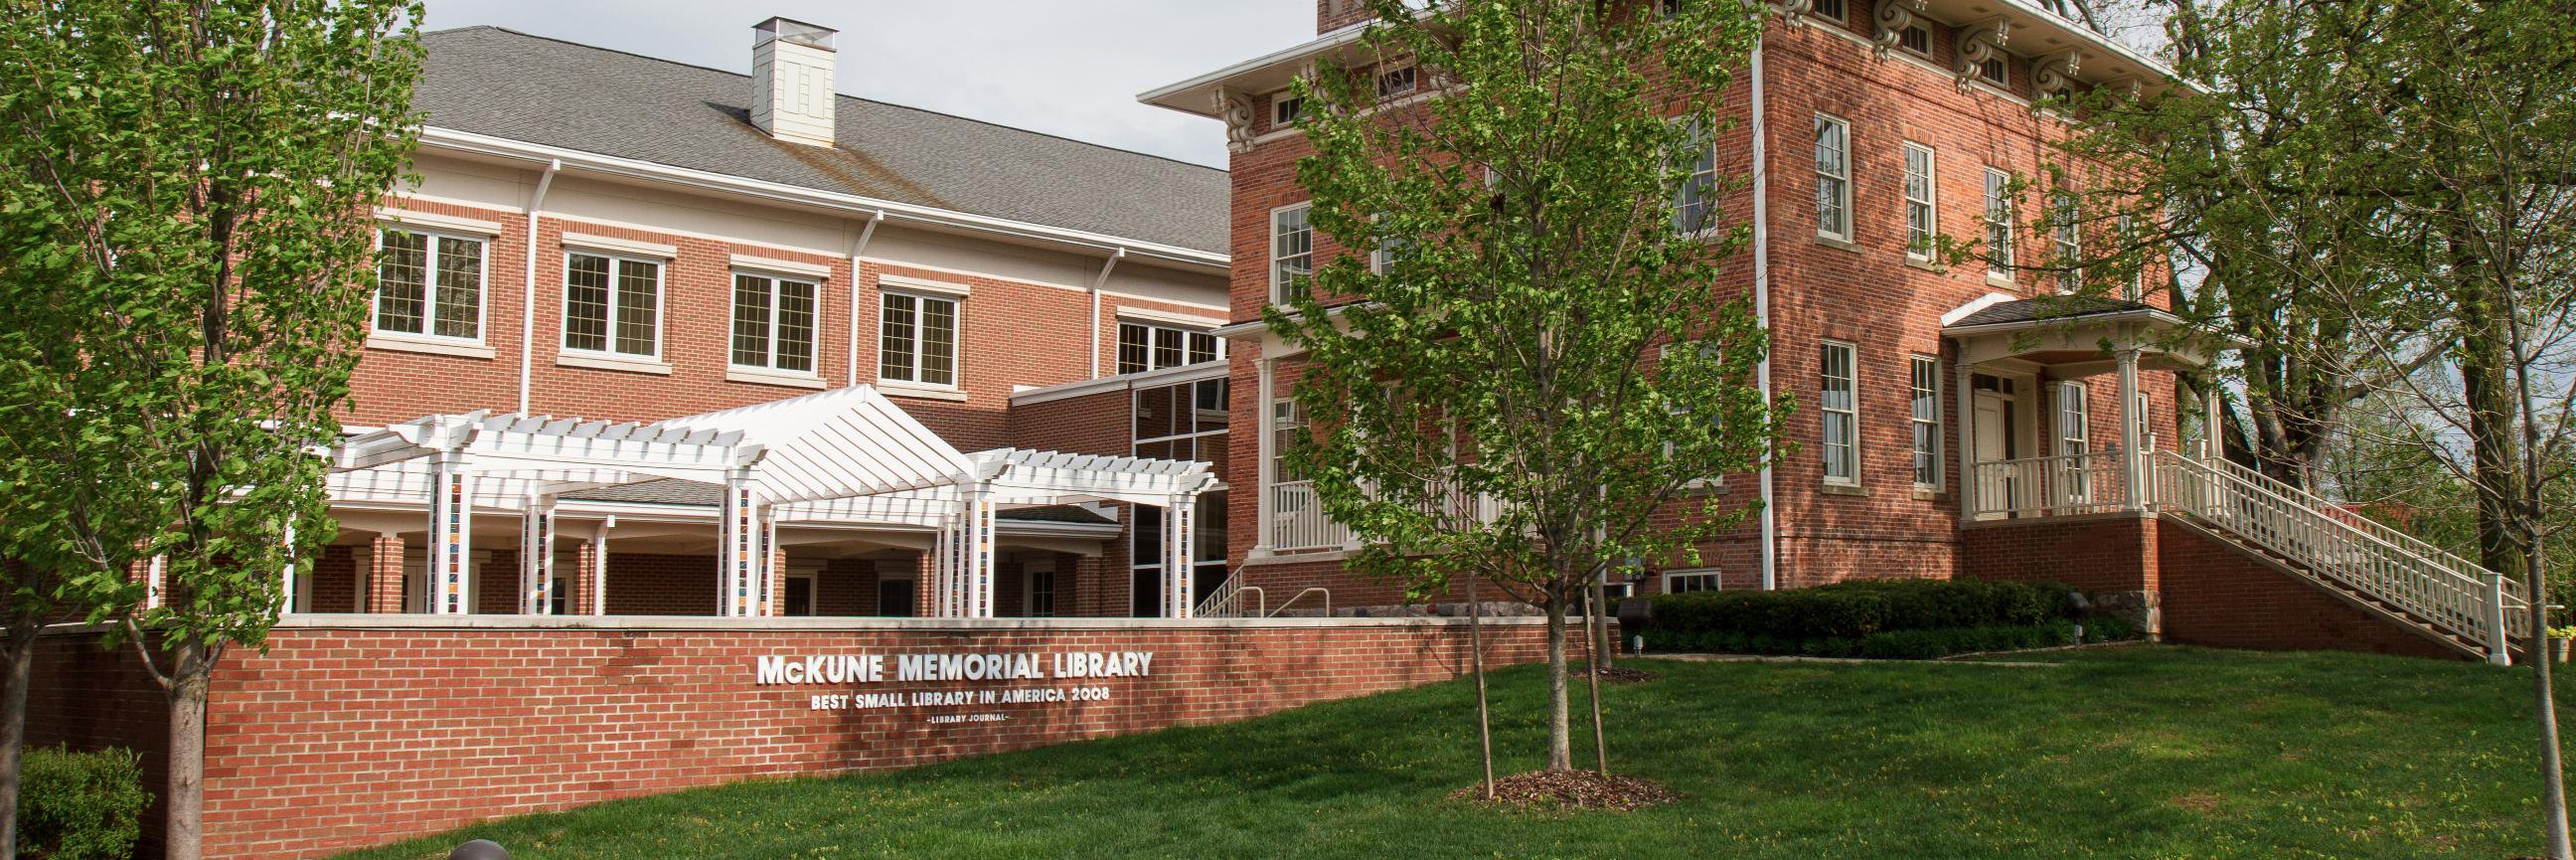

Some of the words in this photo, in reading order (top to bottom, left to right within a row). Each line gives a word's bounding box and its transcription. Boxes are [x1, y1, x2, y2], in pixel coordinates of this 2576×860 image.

[756, 655, 884, 684] McKUNE
[897, 653, 1045, 682] MEMORIAL
[1053, 652, 1154, 679] LIBRARY
[811, 695, 849, 711] BEST
[855, 693, 905, 709] SMALL
[912, 691, 973, 708] LIBRARY
[979, 690, 995, 705] IN
[1001, 689, 1065, 704] AMERICA
[1071, 687, 1110, 702] 2008
